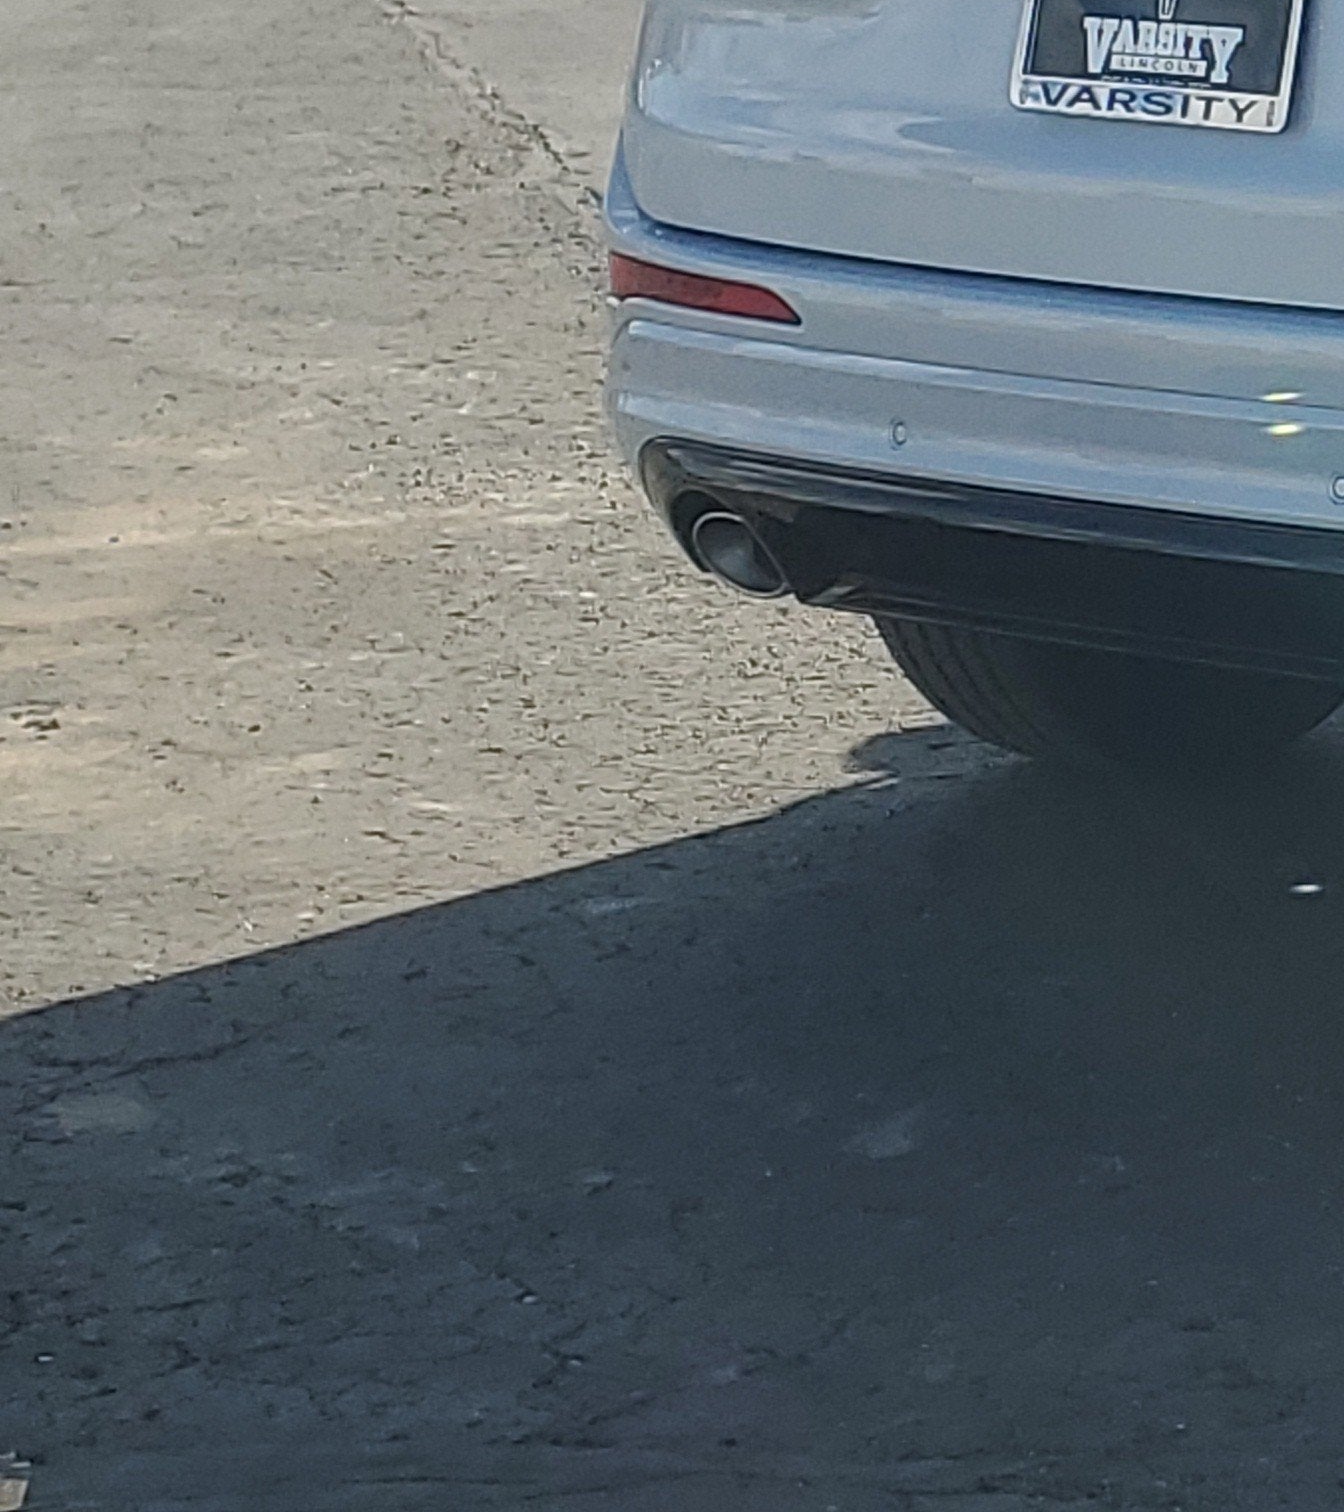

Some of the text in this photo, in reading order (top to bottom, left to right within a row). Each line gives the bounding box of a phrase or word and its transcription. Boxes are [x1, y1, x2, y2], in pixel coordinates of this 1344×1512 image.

[1083, 16, 1244, 83] VARSITY
[1119, 57, 1198, 73] LINCOLN
[1041, 80, 1258, 123] VARSITY
